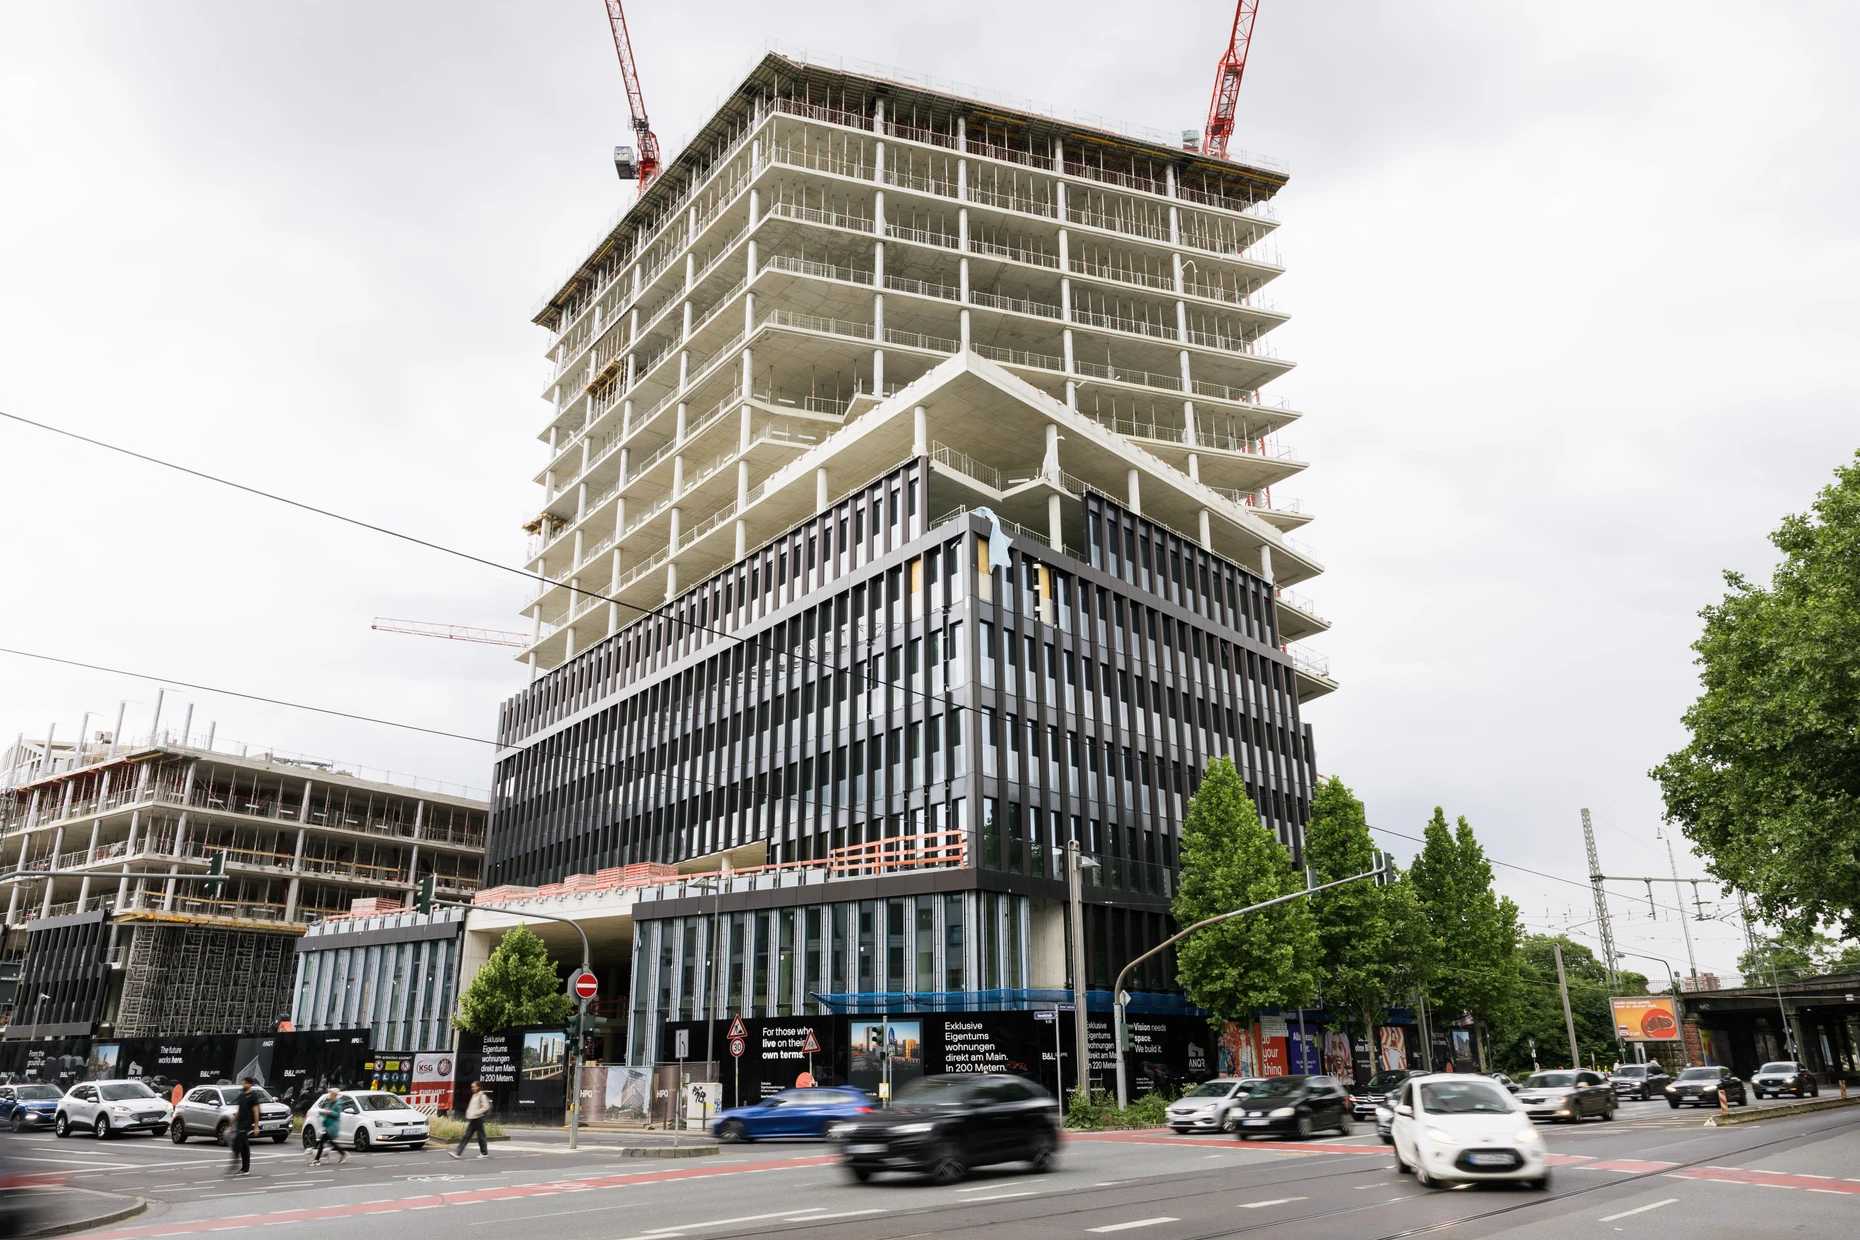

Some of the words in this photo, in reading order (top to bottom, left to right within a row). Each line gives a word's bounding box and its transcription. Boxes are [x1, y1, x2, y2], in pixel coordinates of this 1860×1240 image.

[945, 1022, 983, 1030] Exklusive
[1134, 1023, 1150, 1031] Vision
[763, 1028, 774, 1036] For
[775, 1027, 796, 1036] those
[1087, 1032, 1111, 1040] igentums
[945, 1033, 989, 1042] Eigentums
[1134, 1035, 1152, 1044] space.
[734, 1043, 741, 1052] 30
[762, 1039, 776, 1048] live
[945, 1043, 995, 1052] wohnungen
[482, 1045, 508, 1054] Eigentums
[780, 1050, 805, 1059] terms.
[946, 1053, 969, 1062] direkt
[986, 1052, 1009, 1060] Main.
[1262, 1049, 1278, 1062] your
[482, 1055, 510, 1064] wohnungen
[946, 1064, 954, 1072] In
[955, 1064, 973, 1072] 200
[975, 1064, 1007, 1072] Metern.
[657, 1090, 668, 1098] HPQ
